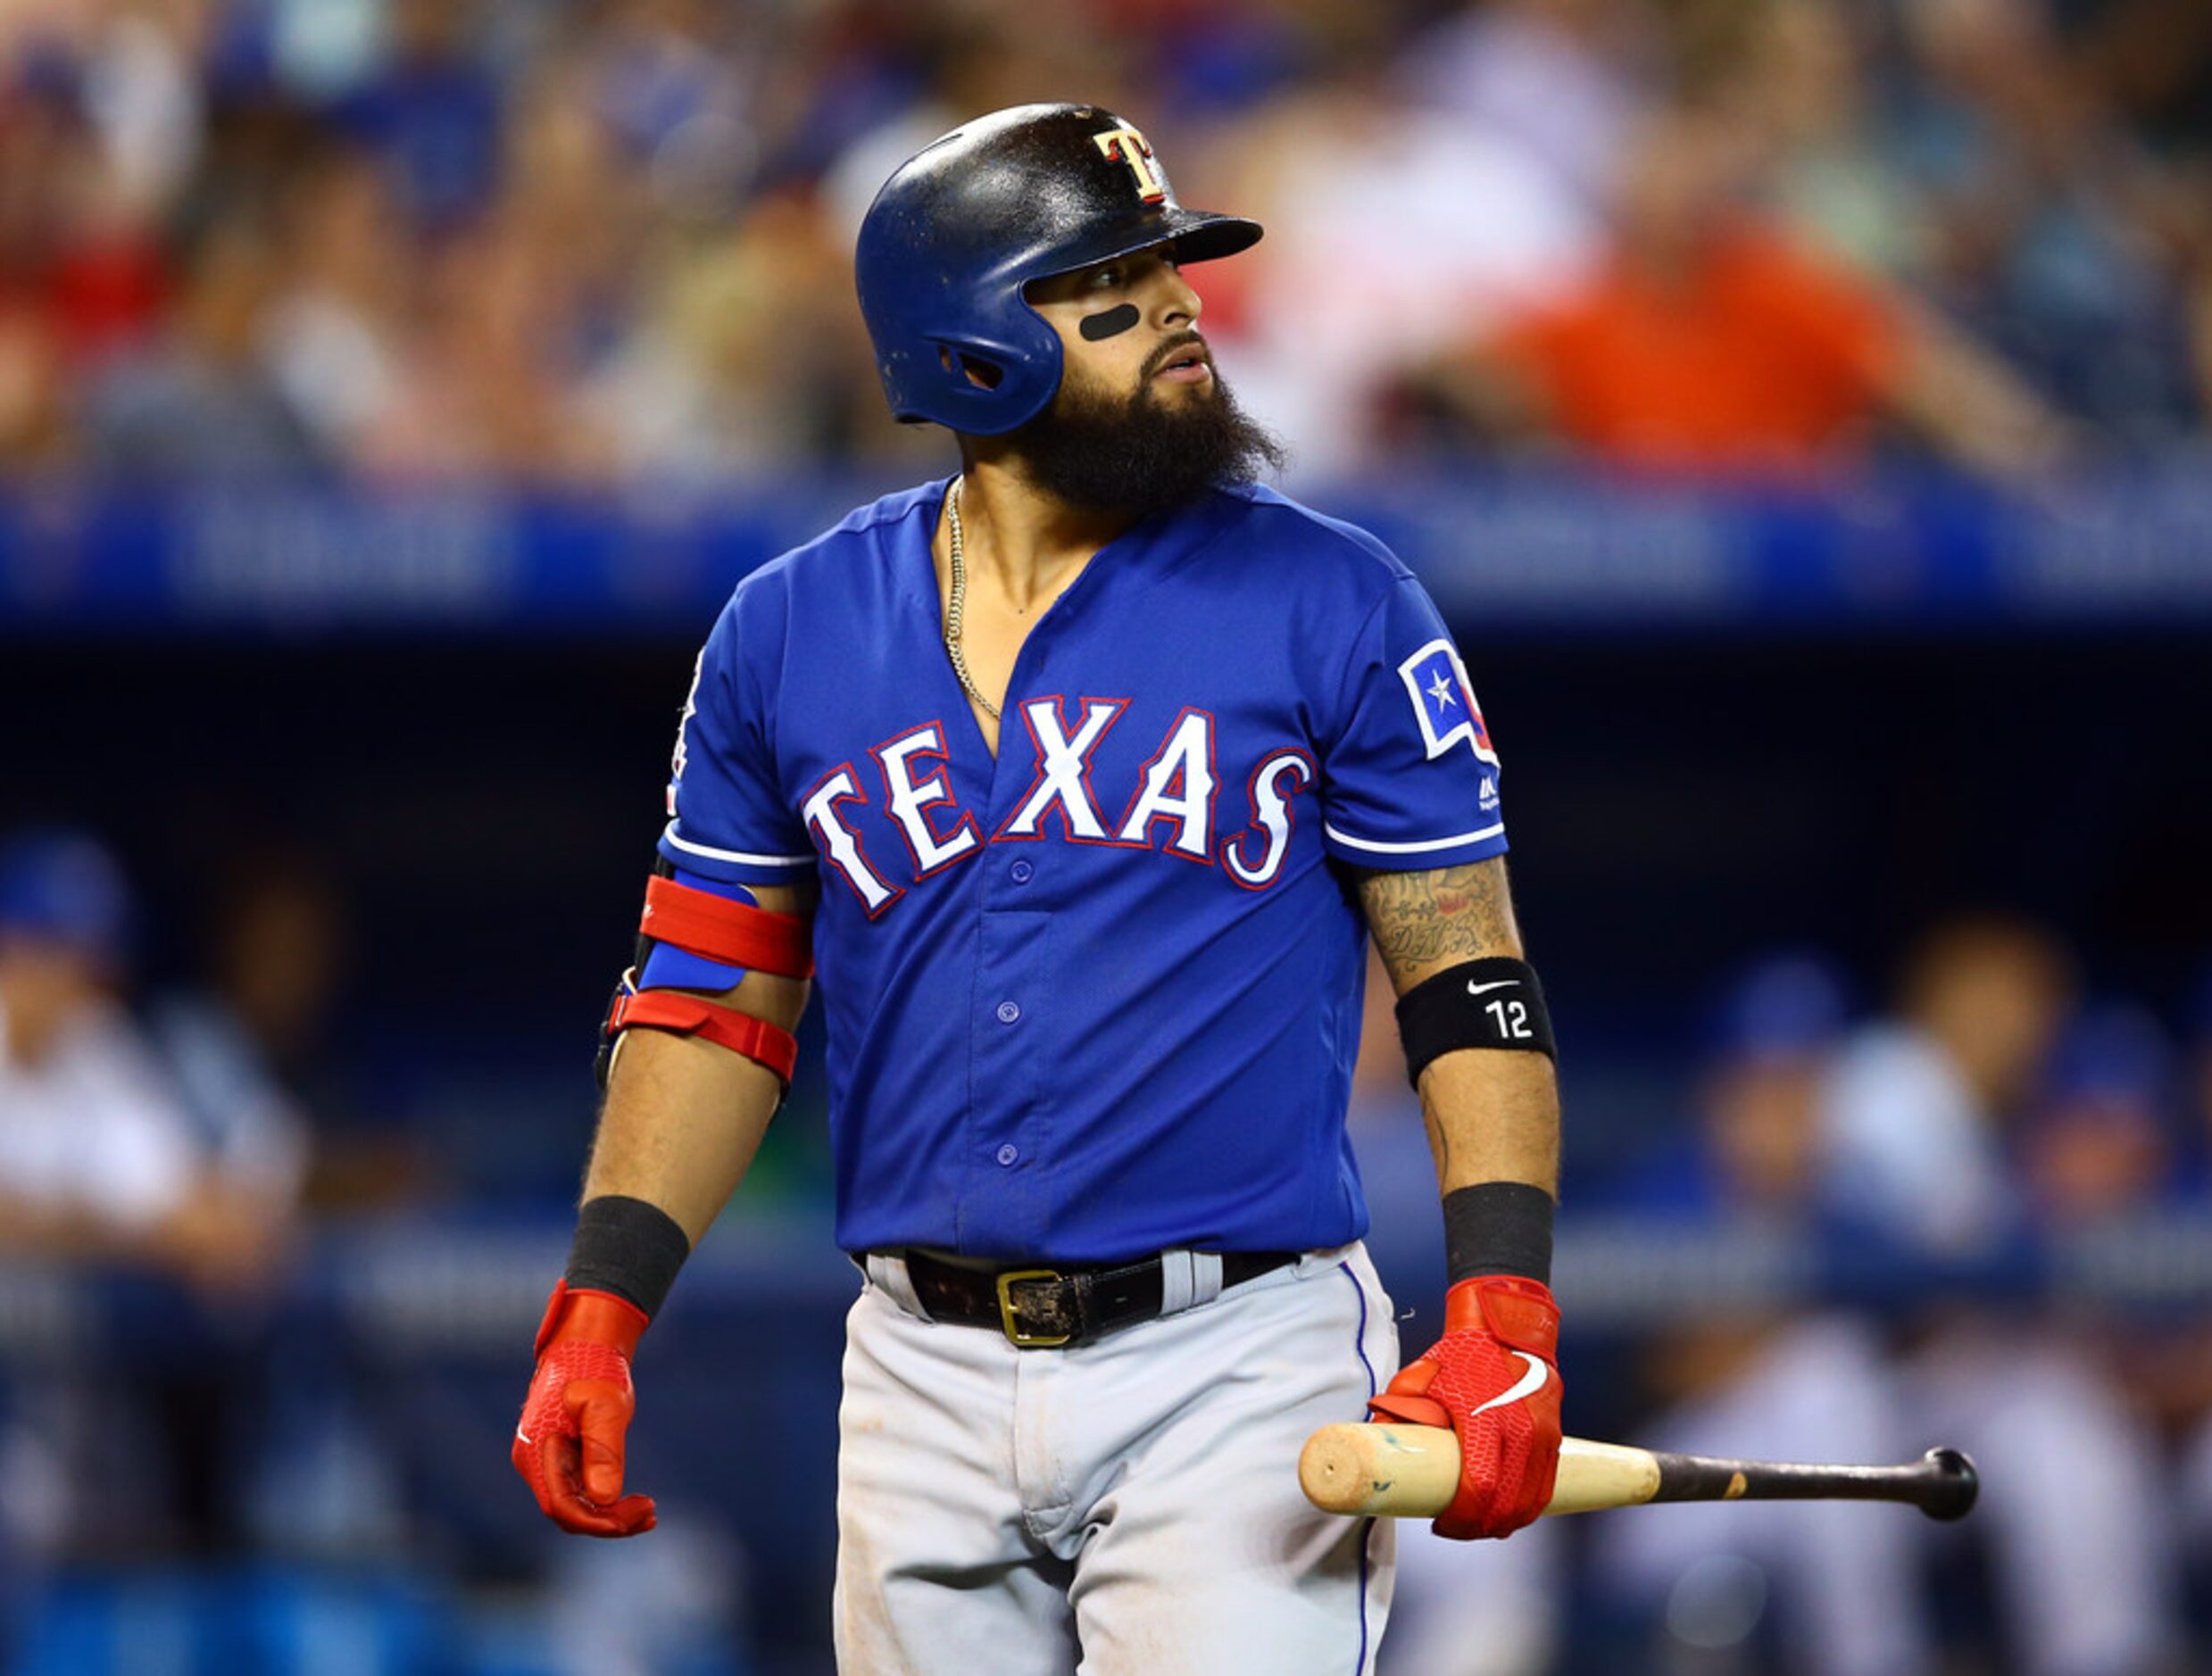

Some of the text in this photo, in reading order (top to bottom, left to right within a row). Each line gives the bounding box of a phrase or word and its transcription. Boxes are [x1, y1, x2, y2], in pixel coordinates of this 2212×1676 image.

[1093, 129, 1165, 203] T
[802, 694, 1317, 920] TEXAS
[1485, 999, 1534, 1039] 12
